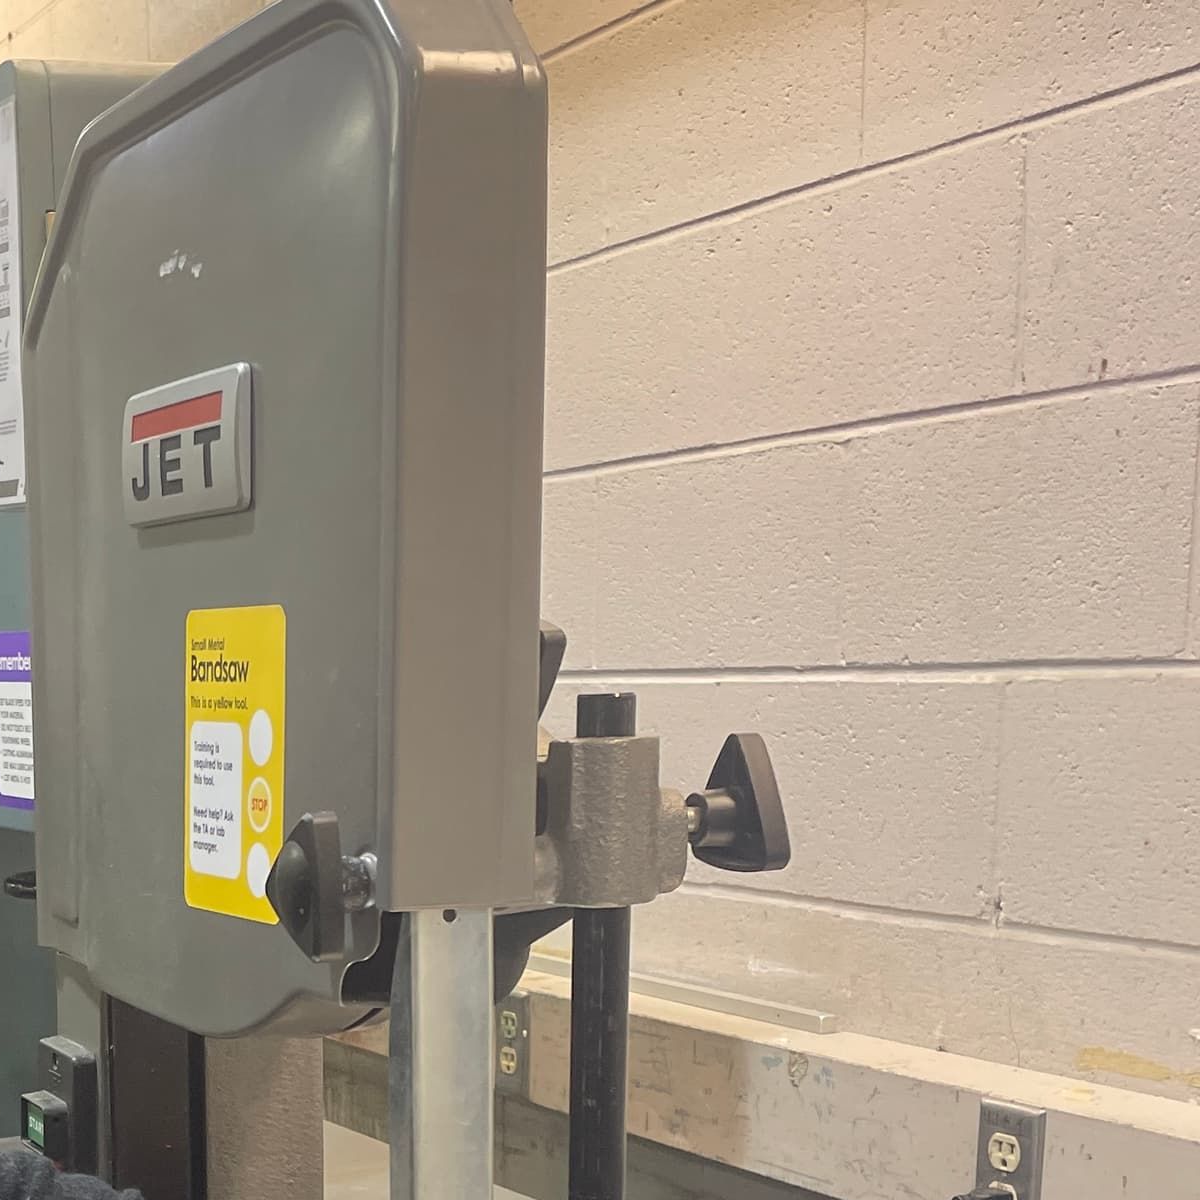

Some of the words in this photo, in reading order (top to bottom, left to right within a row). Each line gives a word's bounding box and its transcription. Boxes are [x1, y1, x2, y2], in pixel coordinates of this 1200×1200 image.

[132, 425, 221, 501] JET
[191, 637, 207, 651] Small
[208, 637, 225, 651] Metal
[191, 654, 249, 682] Bandsaw
[191, 696, 200, 709] This
[201, 697, 207, 709] is
[213, 696, 233, 712] yellow
[234, 697, 248, 710] tool.
[194, 740, 214, 755] Training
[194, 758, 216, 771] required
[216, 759, 222, 770] to
[223, 762, 232, 771] use
[193, 773, 202, 784] this
[203, 774, 215, 786] tool.
[251, 798, 268, 811] STOP
[193, 806, 207, 818] Need
[208, 808, 223, 821] help?
[224, 810, 234, 821] Ask
[193, 822, 201, 833] the
[202, 823, 208, 833] TA
[210, 826, 215, 835] or
[193, 841, 218, 854] manager.
